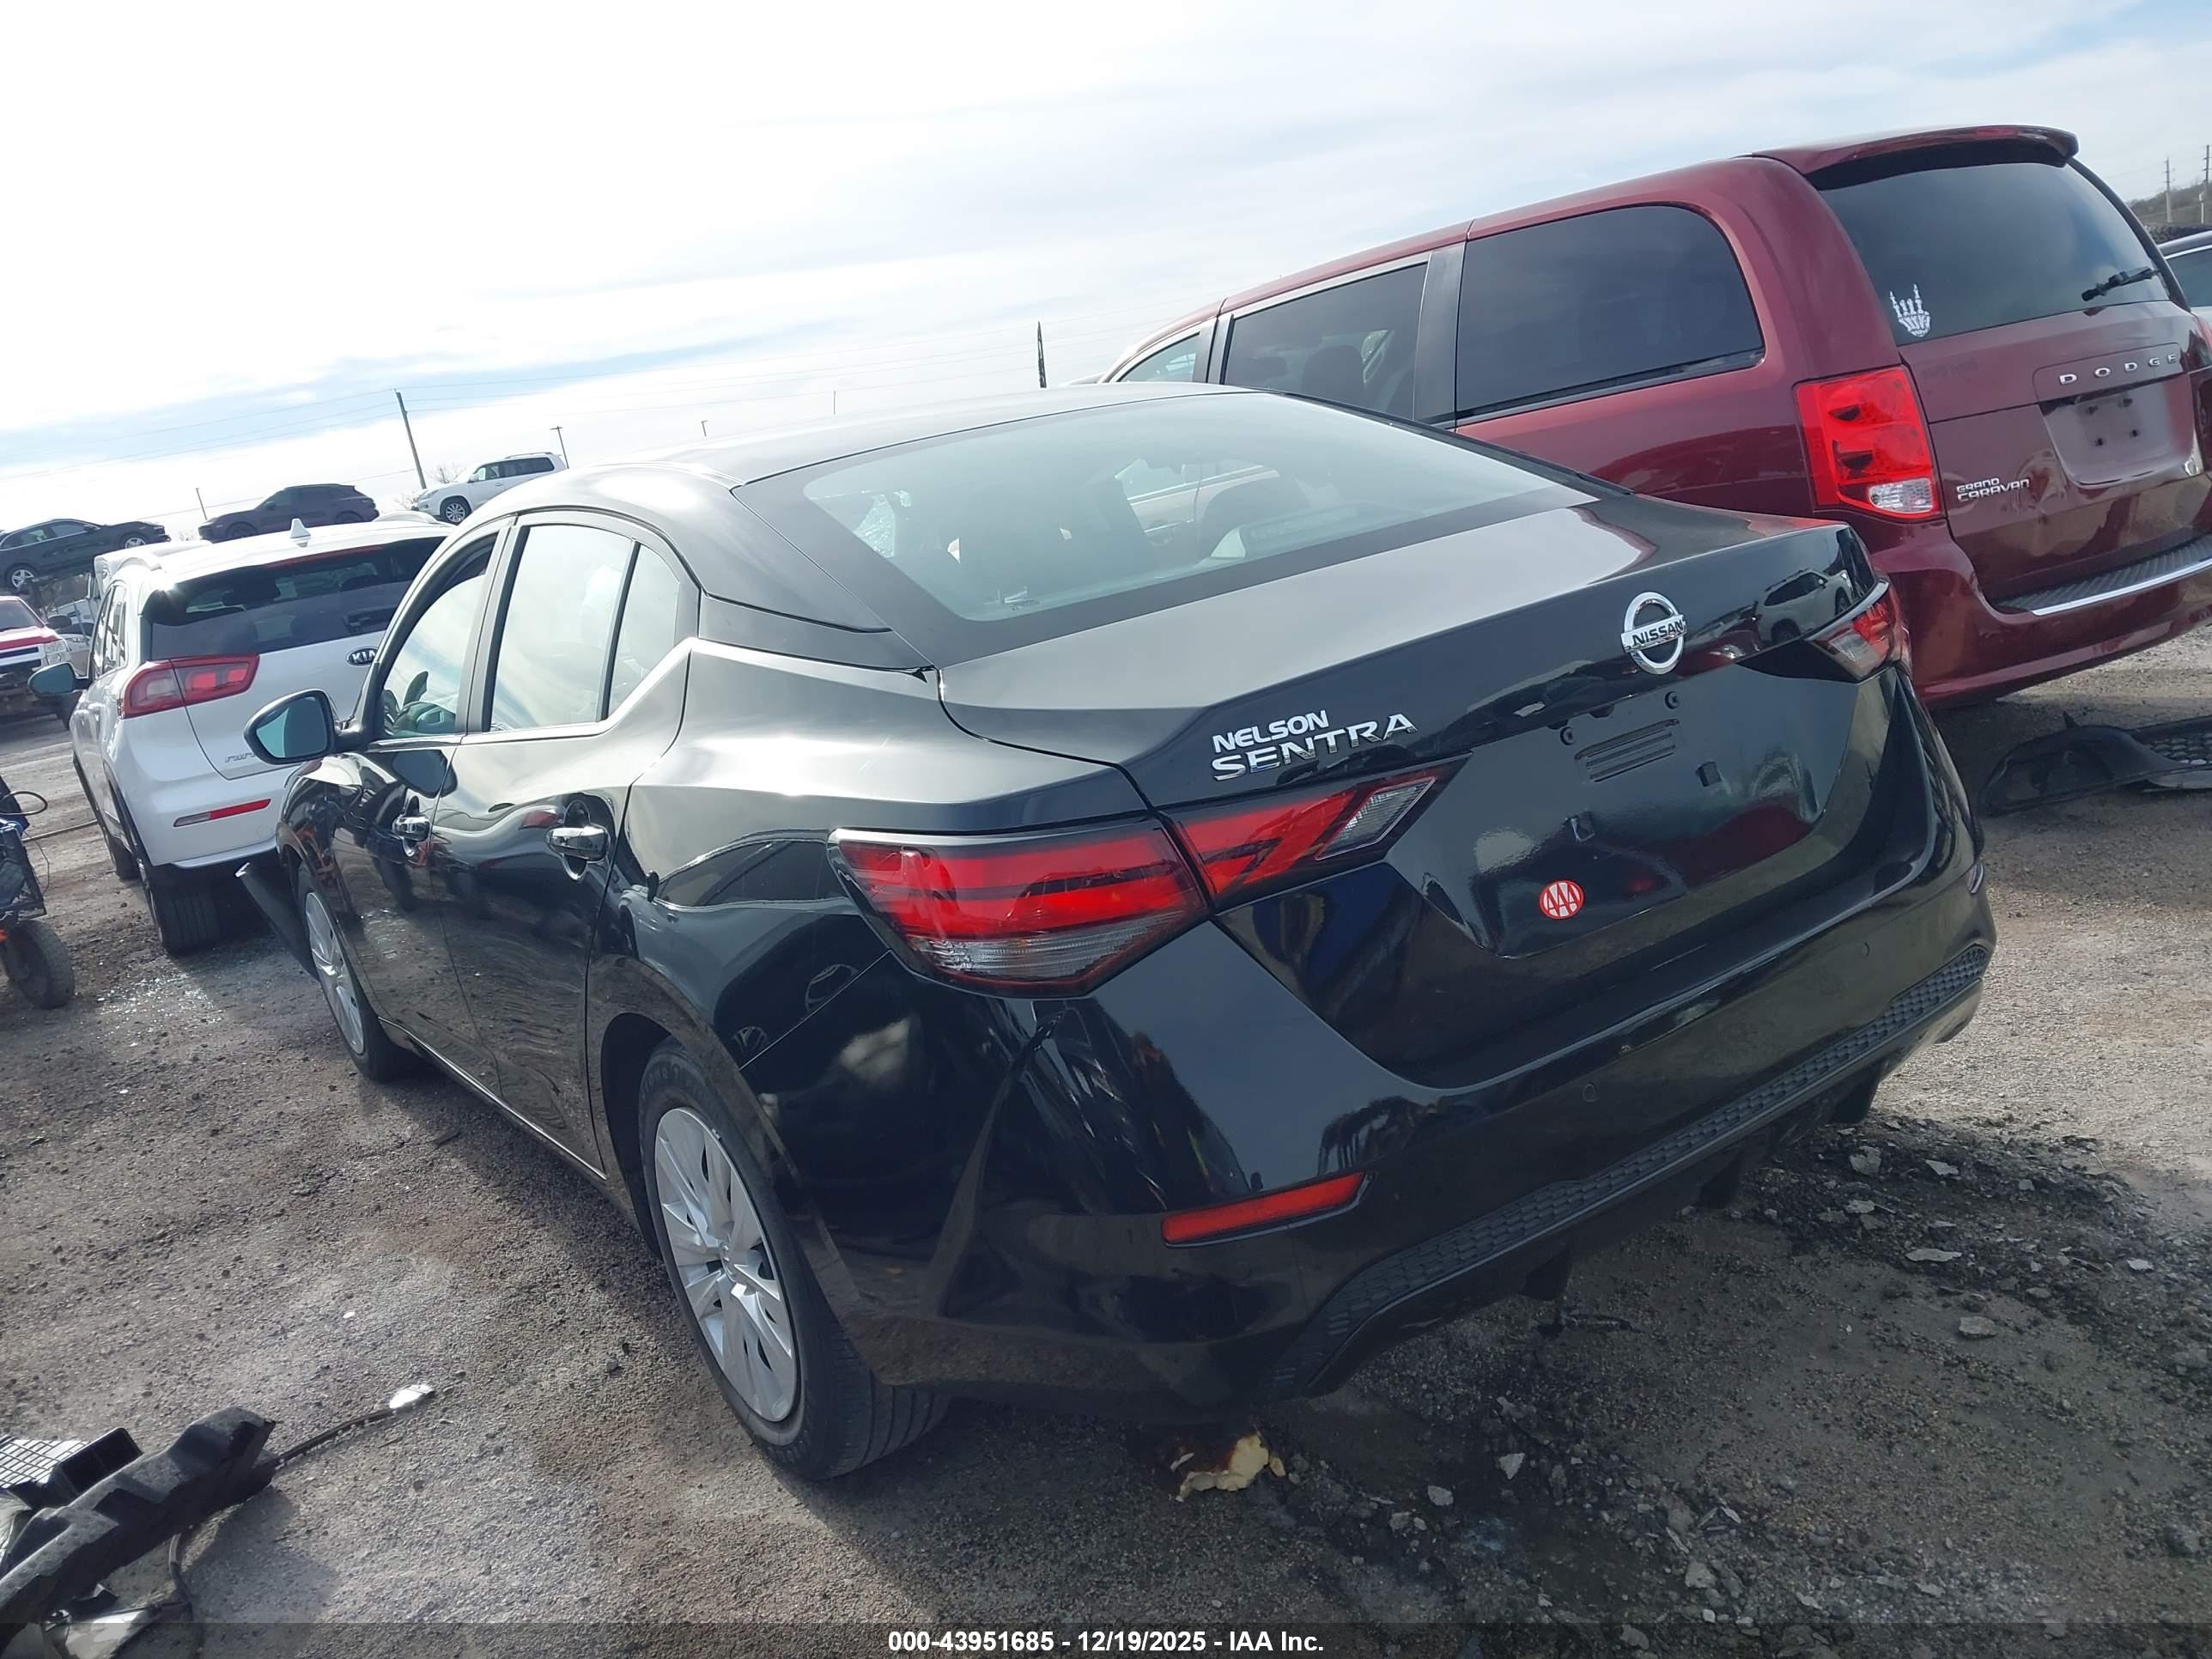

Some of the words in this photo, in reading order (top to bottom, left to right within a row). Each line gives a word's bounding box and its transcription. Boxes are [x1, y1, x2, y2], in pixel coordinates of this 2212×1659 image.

[2058, 353, 2179, 385] DODGE
[1956, 477, 2000, 493] GRAND
[1957, 478, 2030, 502] CARAVAN
[1632, 618, 1684, 647] NISSAN
[1211, 713, 1418, 781] SENTRA
[1212, 709, 1329, 754] NELSON
[1542, 882, 1581, 918] AAA
